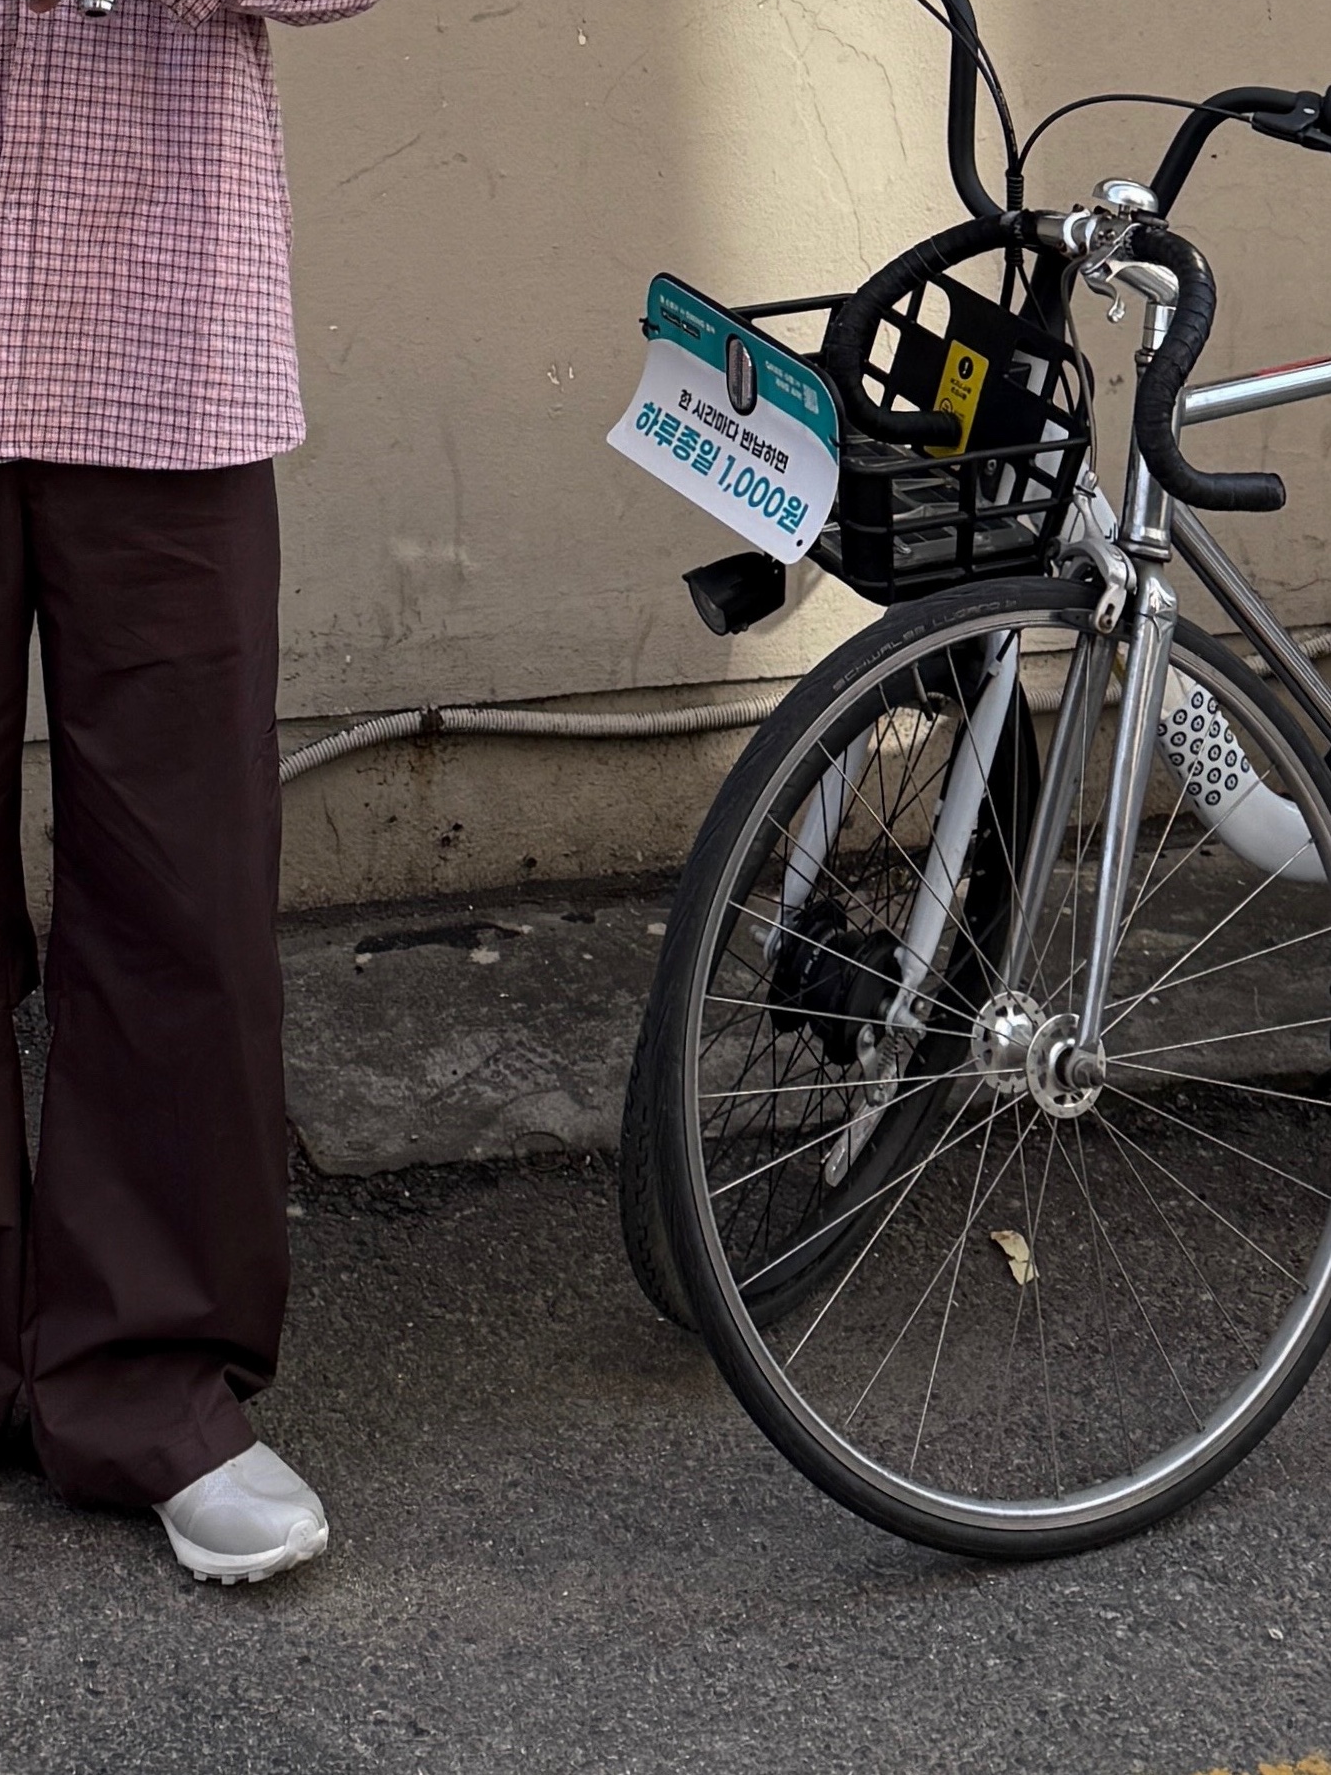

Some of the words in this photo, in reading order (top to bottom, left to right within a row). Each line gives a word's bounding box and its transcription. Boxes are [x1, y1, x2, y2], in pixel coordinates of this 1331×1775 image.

[635, 401, 722, 477] 하루종일
[717, 454, 810, 536] 1,000원
[678, 389, 693, 411] 한
[692, 399, 740, 442] 시간마다
[739, 429, 790, 475] 반납하면
